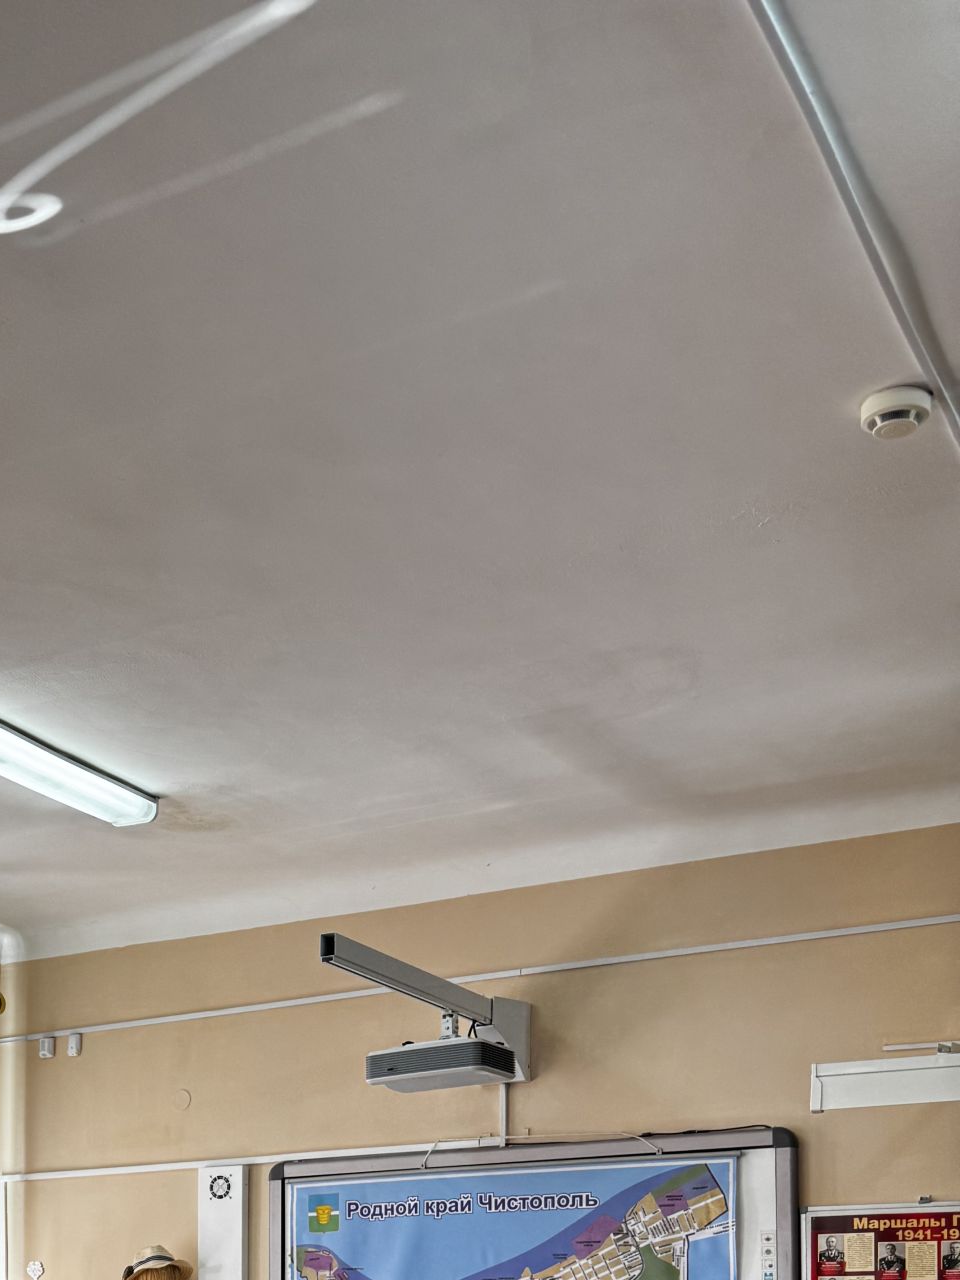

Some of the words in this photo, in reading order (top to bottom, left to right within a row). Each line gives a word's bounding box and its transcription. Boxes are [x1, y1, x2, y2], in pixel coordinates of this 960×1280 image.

[346, 1197, 420, 1221] Родной
[424, 1194, 473, 1219] край
[478, 1192, 600, 1213] Чистополь
[853, 1216, 946, 1231] Маршалы
